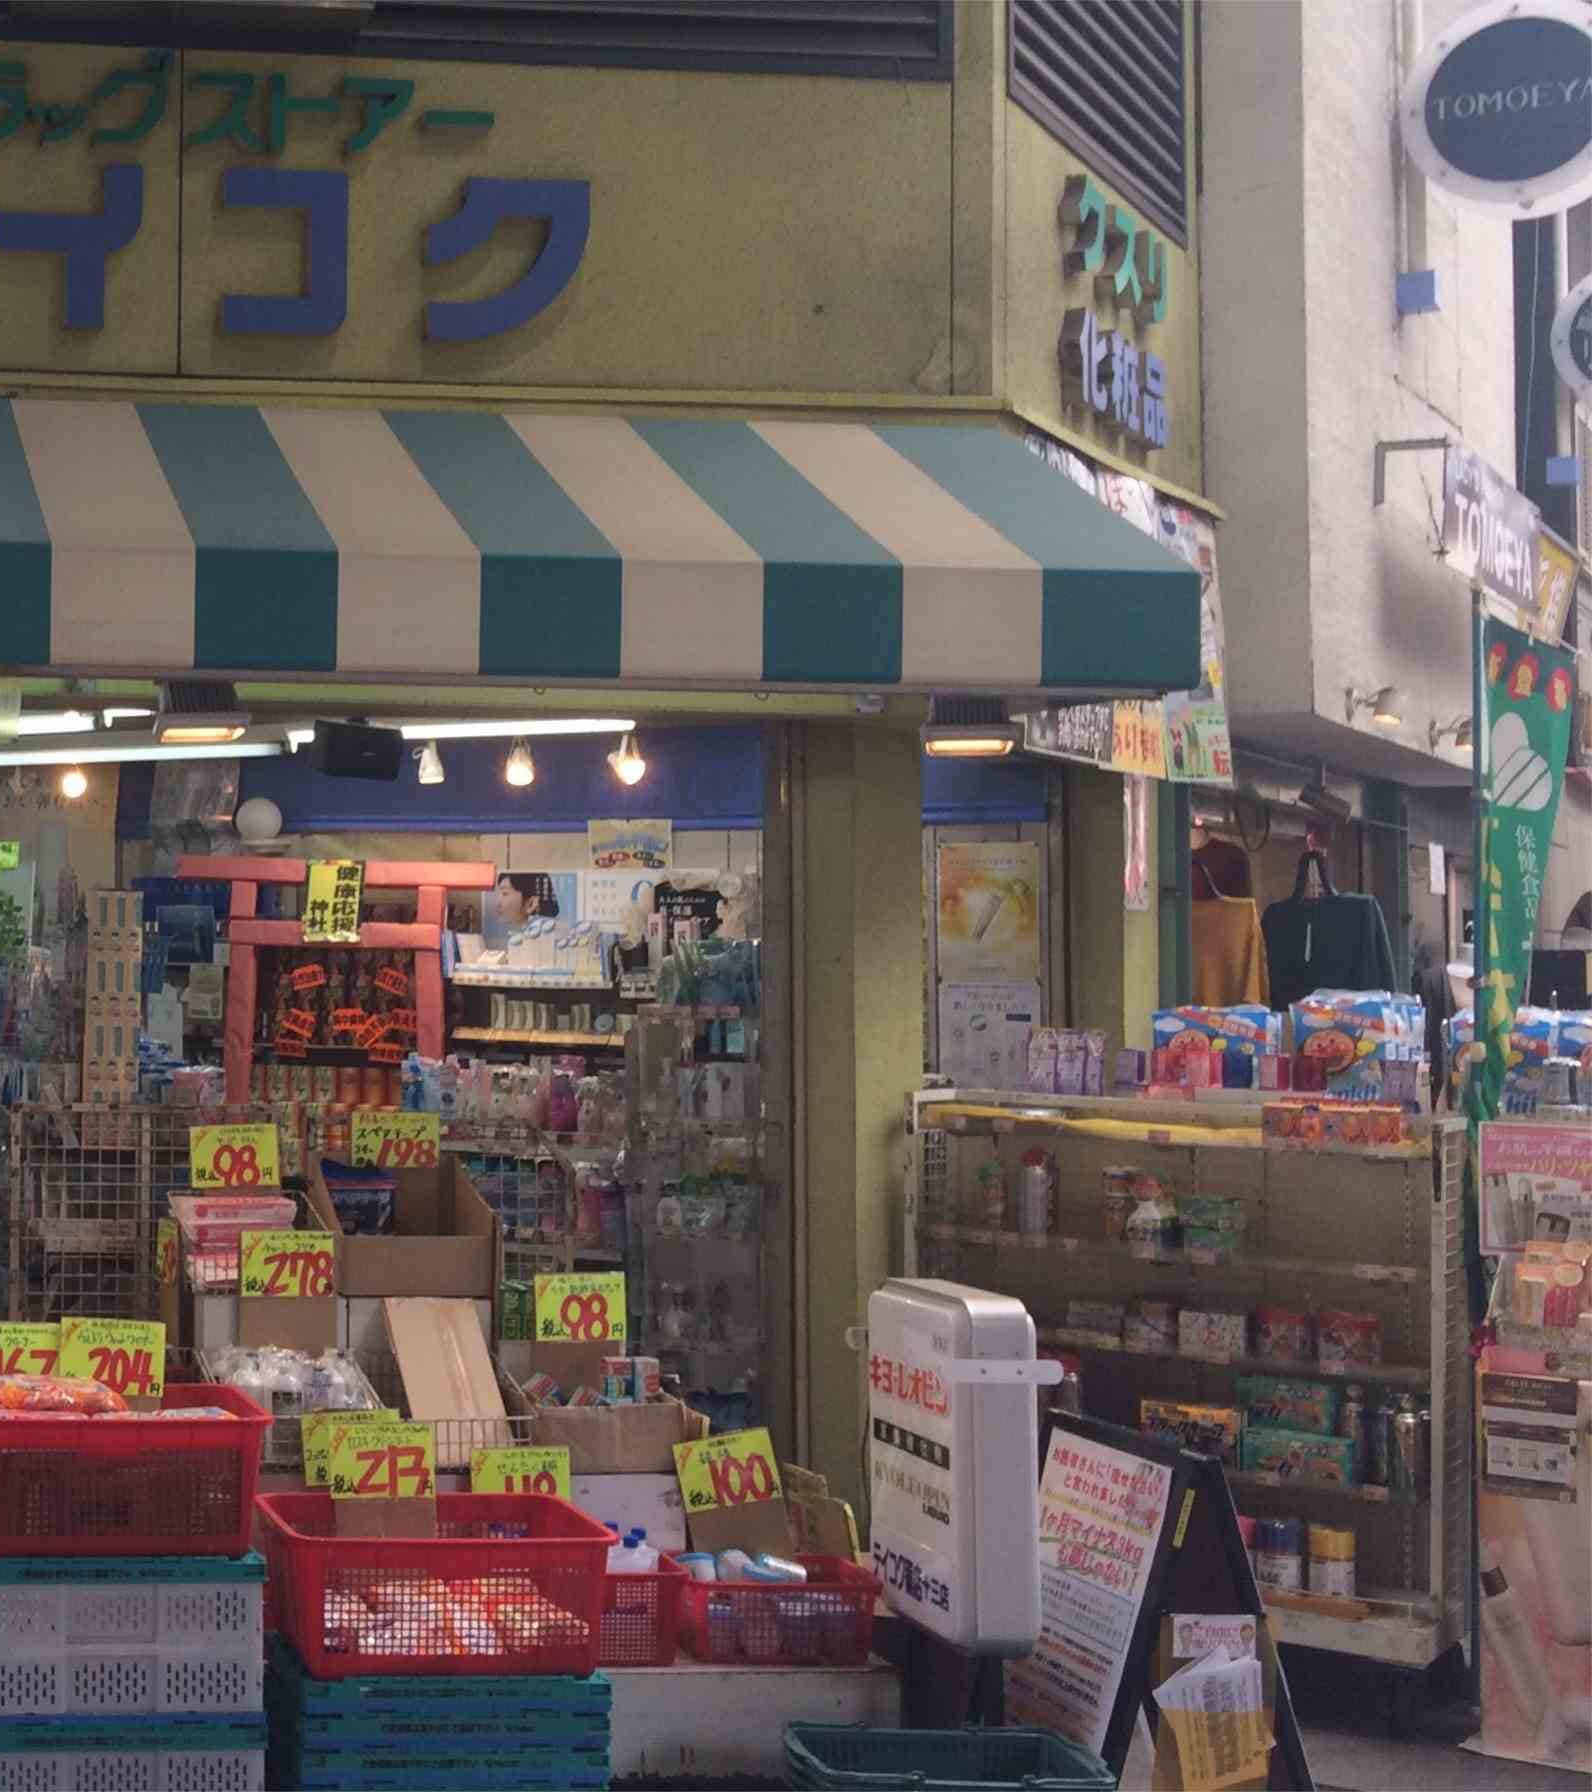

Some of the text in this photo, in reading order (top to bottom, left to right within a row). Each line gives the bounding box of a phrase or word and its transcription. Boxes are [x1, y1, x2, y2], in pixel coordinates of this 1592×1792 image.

[1064, 174, 1166, 324] クスリ
[1068, 308, 1170, 450] 化粧品
[212, 1144, 261, 1186] 98
[377, 1138, 436, 1168] 198
[263, 1250, 336, 1297] 278
[560, 1292, 610, 1341] 98
[88, 1346, 154, 1394] 204
[708, 1452, 775, 1506] 100
